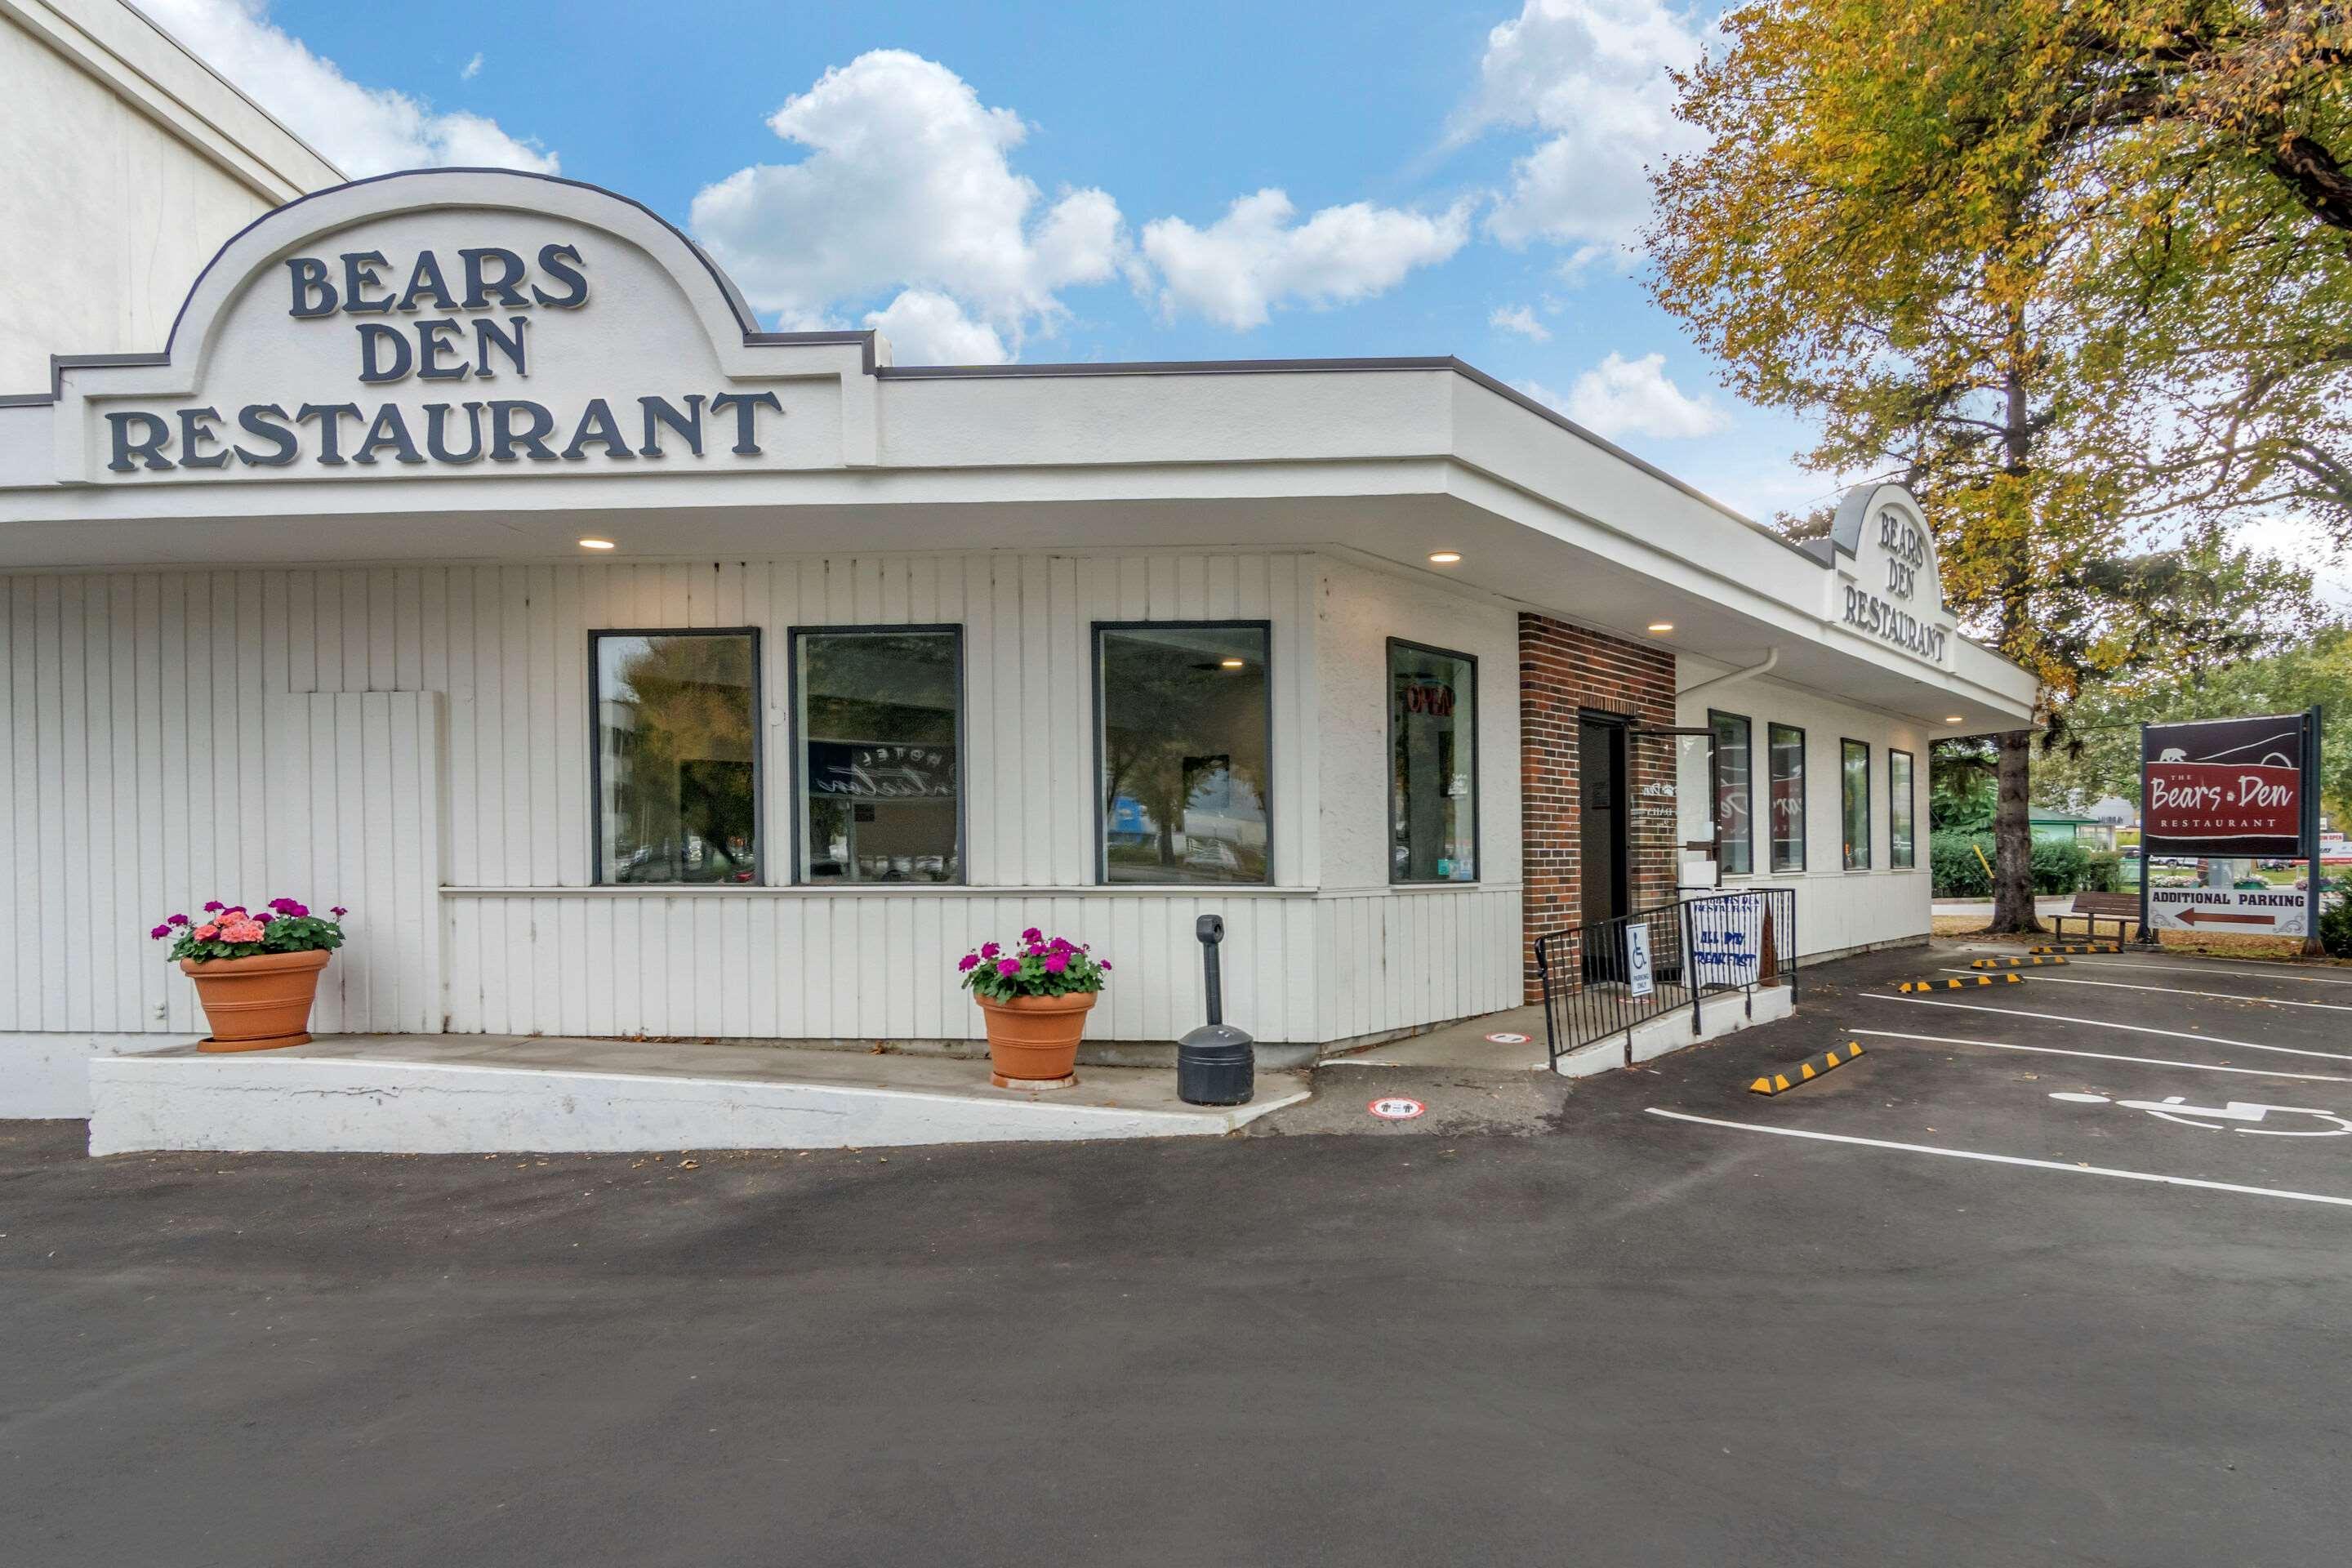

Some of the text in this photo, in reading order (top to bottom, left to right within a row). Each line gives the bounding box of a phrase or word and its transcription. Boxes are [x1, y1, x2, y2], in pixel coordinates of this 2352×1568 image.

[287, 243, 588, 317] BEARS
[356, 316, 528, 383] DEN
[105, 391, 782, 471] RESTAURANT
[1879, 511, 1923, 568] BEARS
[1886, 557, 1914, 601] DEN
[1843, 585, 1945, 662] RESTAURANT
[1407, 684, 1454, 716] OPEN
[2238, 775, 2293, 807] Den
[2161, 819, 2276, 827] RESTAURANT
[2153, 892, 2305, 907] ADDITIONAL PARKING
